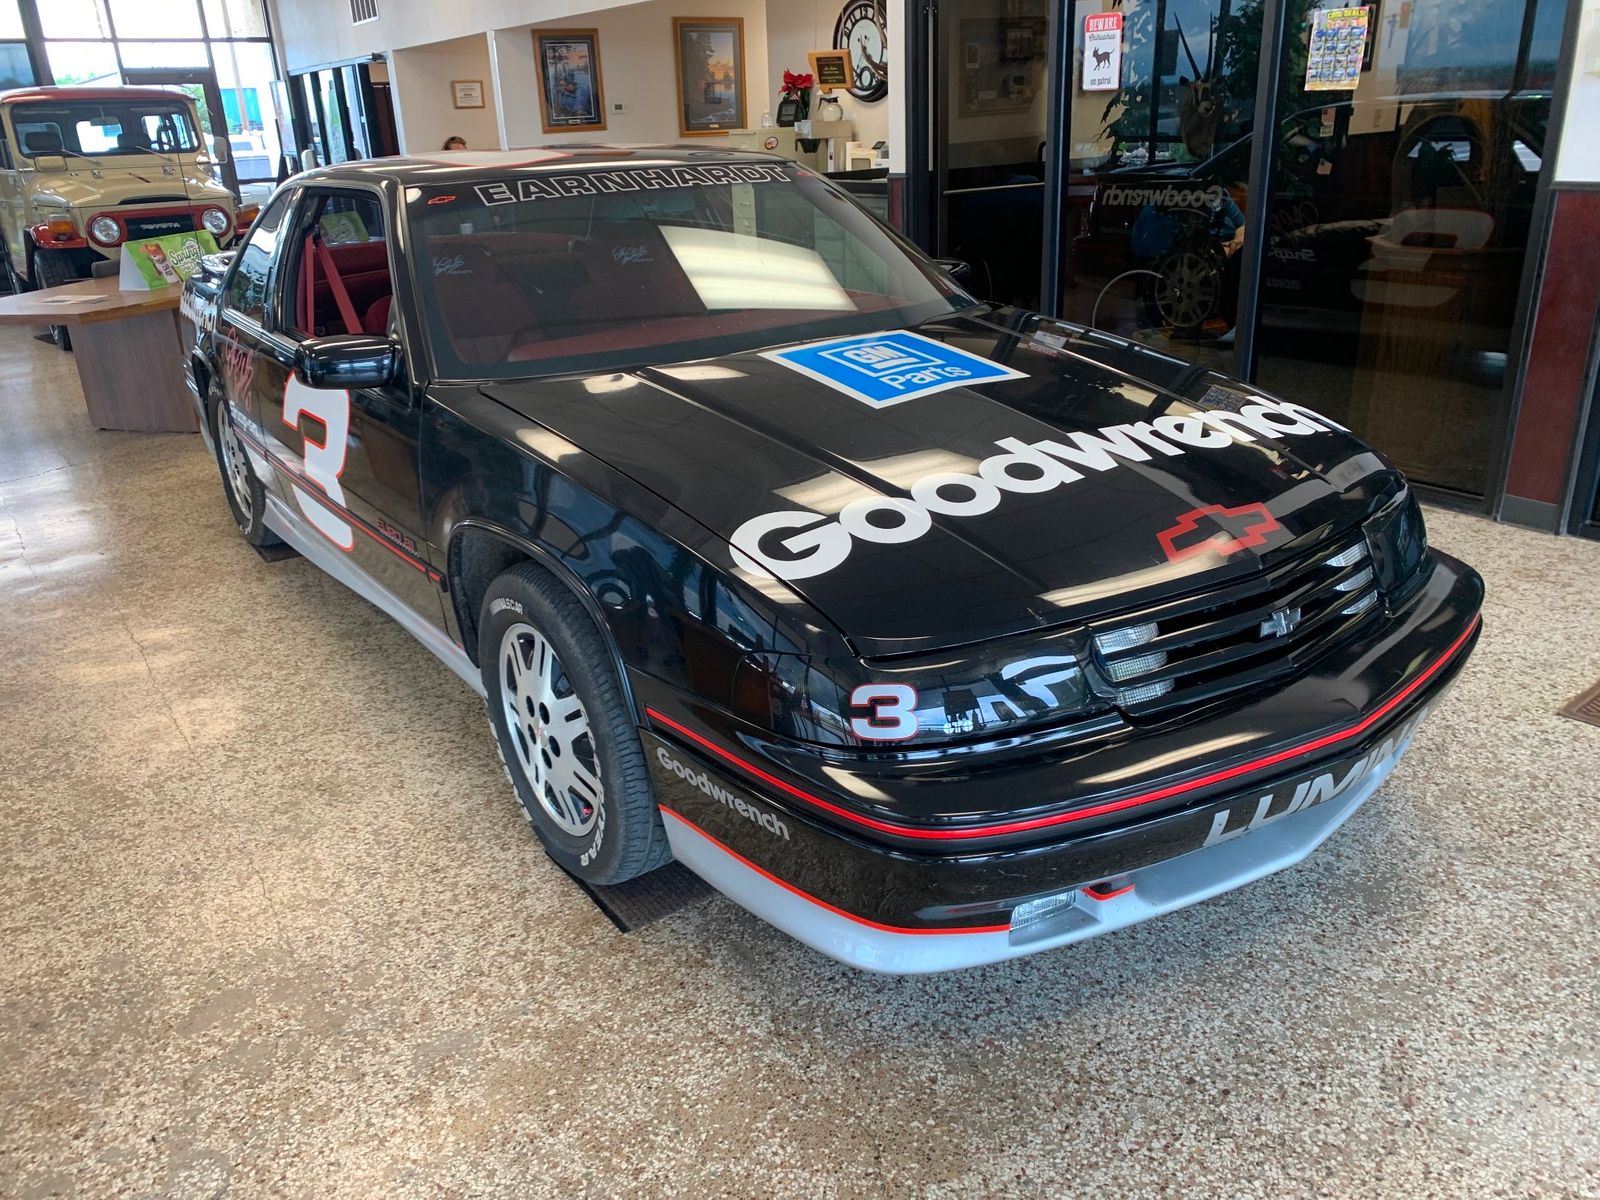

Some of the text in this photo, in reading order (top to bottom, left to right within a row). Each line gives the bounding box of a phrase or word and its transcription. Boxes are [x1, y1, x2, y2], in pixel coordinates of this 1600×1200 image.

[1088, 17, 1118, 32] BEWARE
[1097, 76, 1112, 86] patrol
[473, 162, 793, 207] EARNHARDT
[140, 221, 181, 230] TOYOTA
[842, 345, 904, 365] GM
[878, 364, 973, 390] Parts
[282, 369, 354, 553] 3
[728, 395, 1353, 582] Goodwrench
[499, 597, 524, 616] NASCAR
[850, 682, 919, 742] 3
[656, 745, 791, 841] Goodwrench
